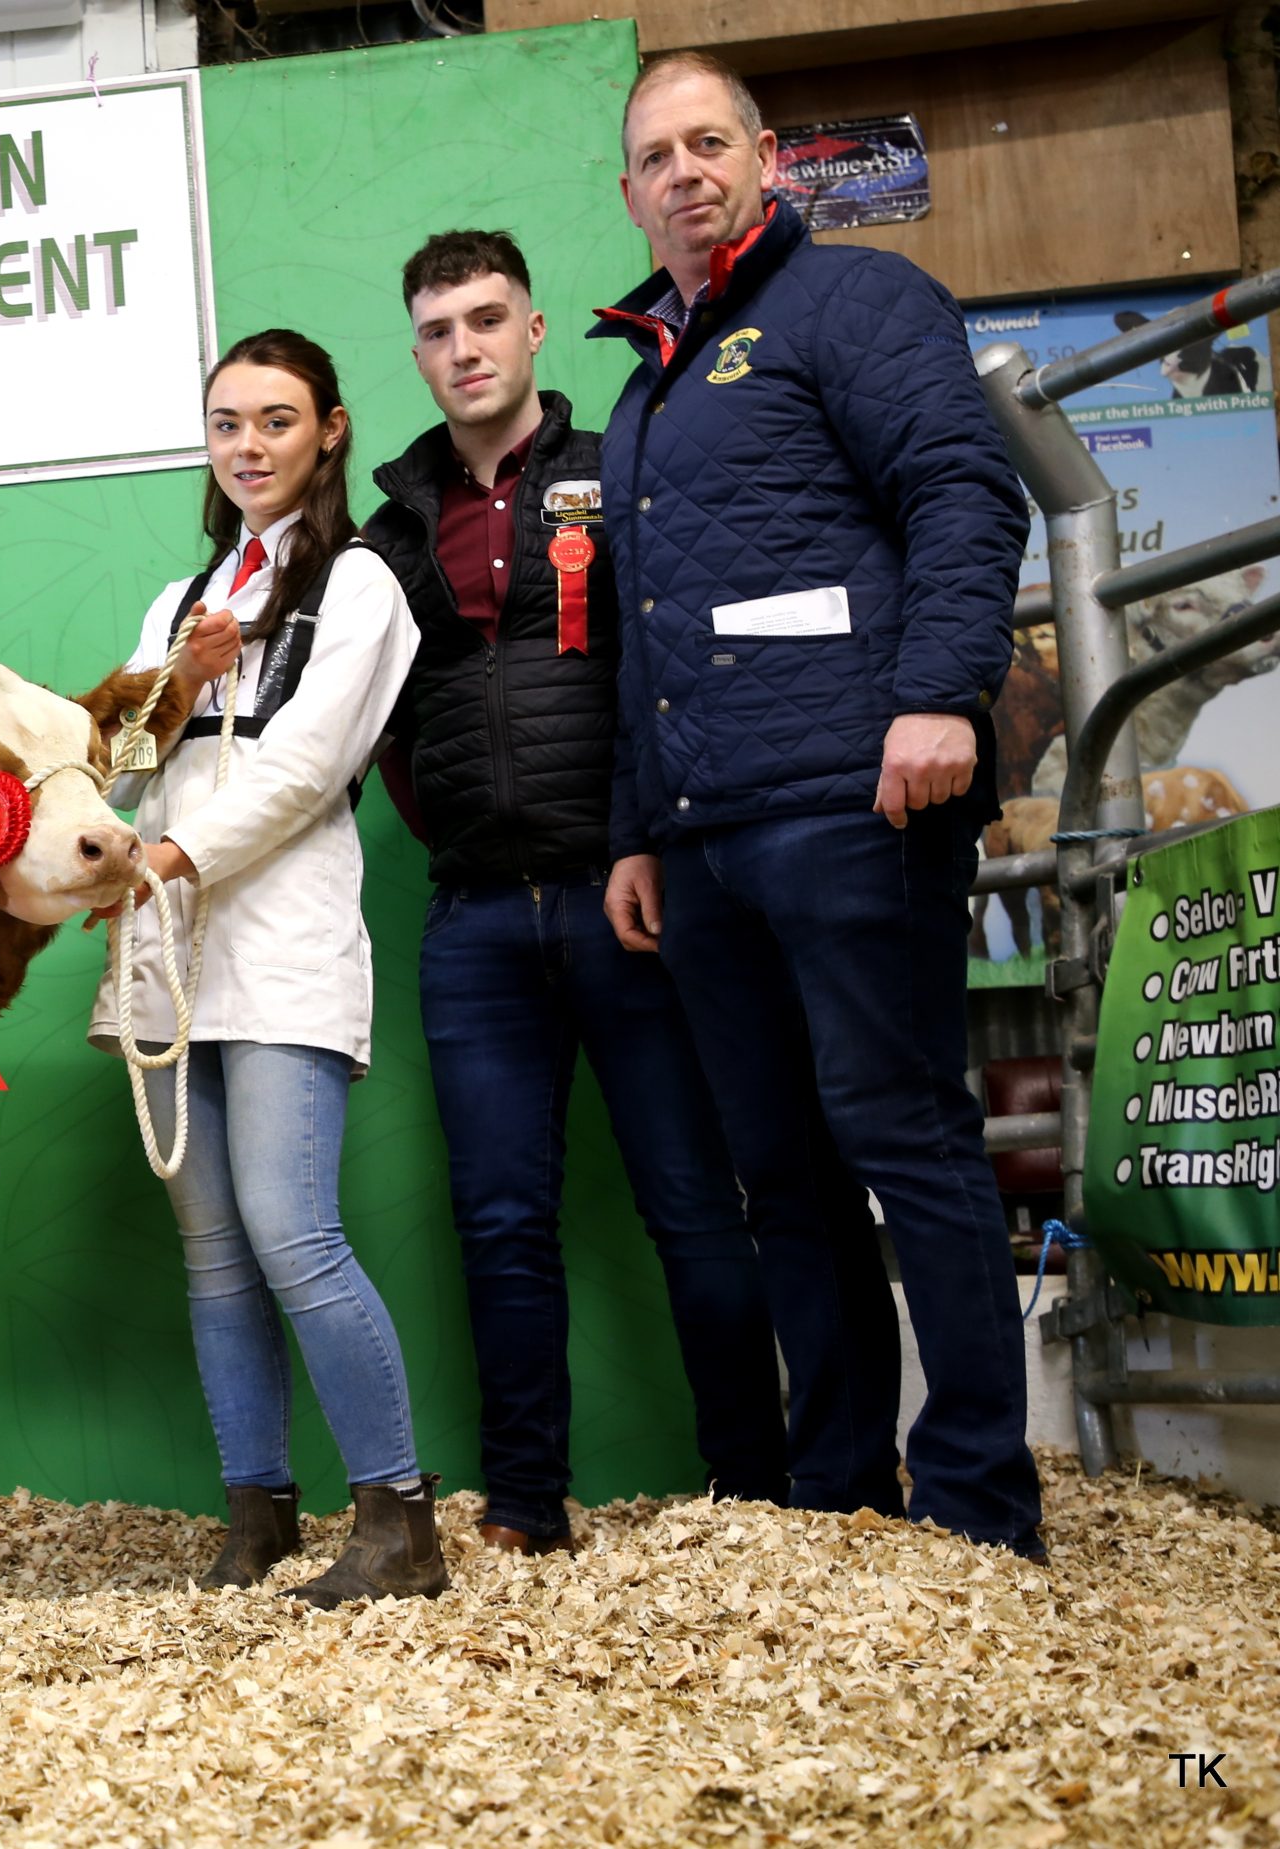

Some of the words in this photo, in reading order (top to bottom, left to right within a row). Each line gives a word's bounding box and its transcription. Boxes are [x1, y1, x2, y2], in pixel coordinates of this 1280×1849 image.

[975, 310, 1040, 332] Owned
[1068, 411, 1102, 424] wear
[1106, 407, 1130, 420] the
[1132, 404, 1164, 417] Irish
[1169, 402, 1193, 416] Tag
[1196, 398, 1227, 412] with
[1231, 394, 1269, 409] Pride
[1169, 957, 1221, 1003] Cow
[1157, 1011, 1275, 1063] Newborn
